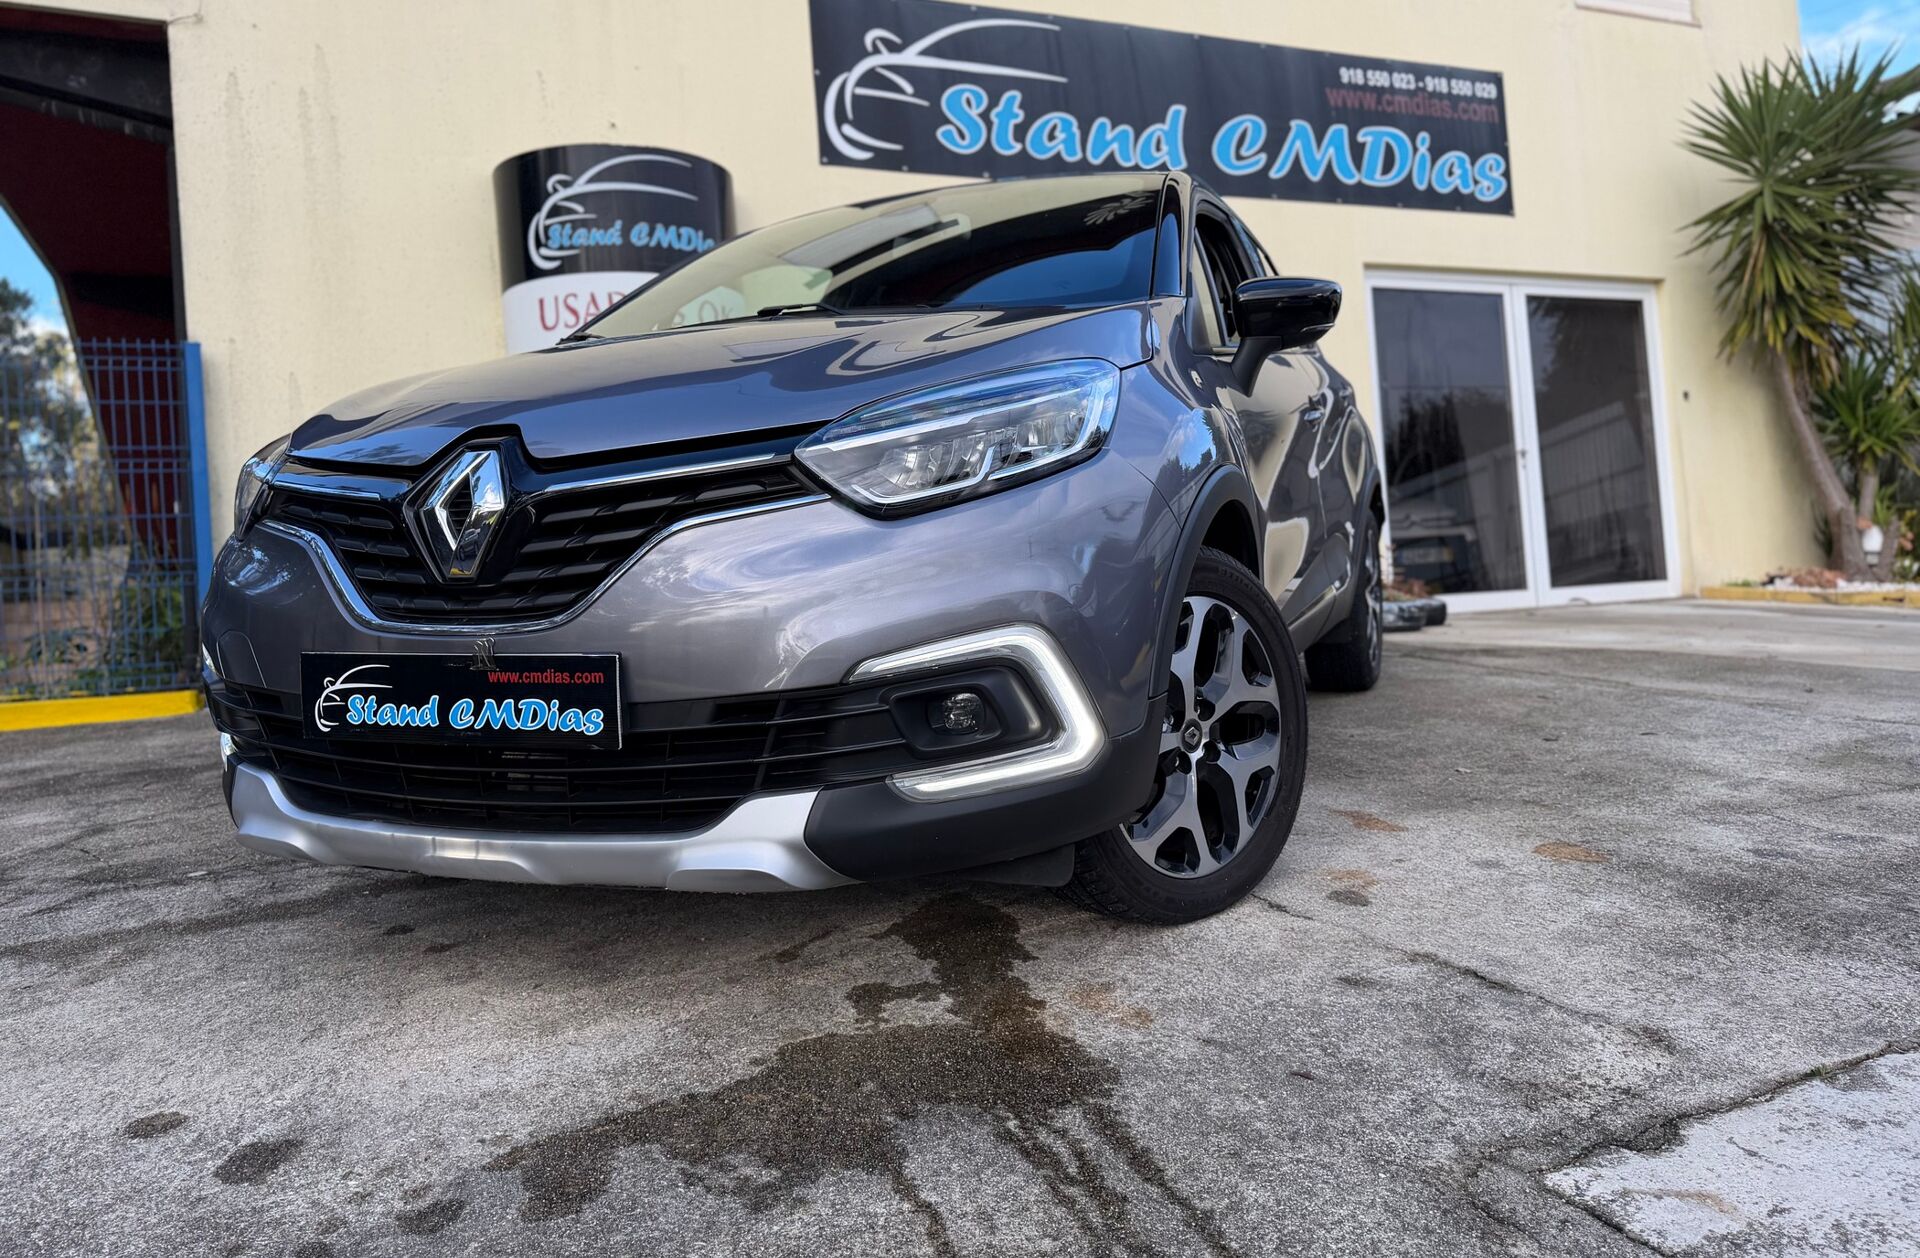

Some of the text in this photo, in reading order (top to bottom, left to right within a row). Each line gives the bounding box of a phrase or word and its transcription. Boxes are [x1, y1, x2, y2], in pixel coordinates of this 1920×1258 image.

[1339, 66, 1364, 86] 918
[1366, 69, 1391, 89] 550
[1392, 72, 1416, 91] 023
[1424, 75, 1448, 94] 918
[1450, 78, 1473, 98] 550
[1325, 87, 1499, 123] www.cmdias.com
[937, 83, 1507, 202] Stand CMDias
[546, 219, 623, 250] Stand
[487, 668, 604, 684] www.cmdias.com
[346, 695, 604, 736] Stand CMDias
